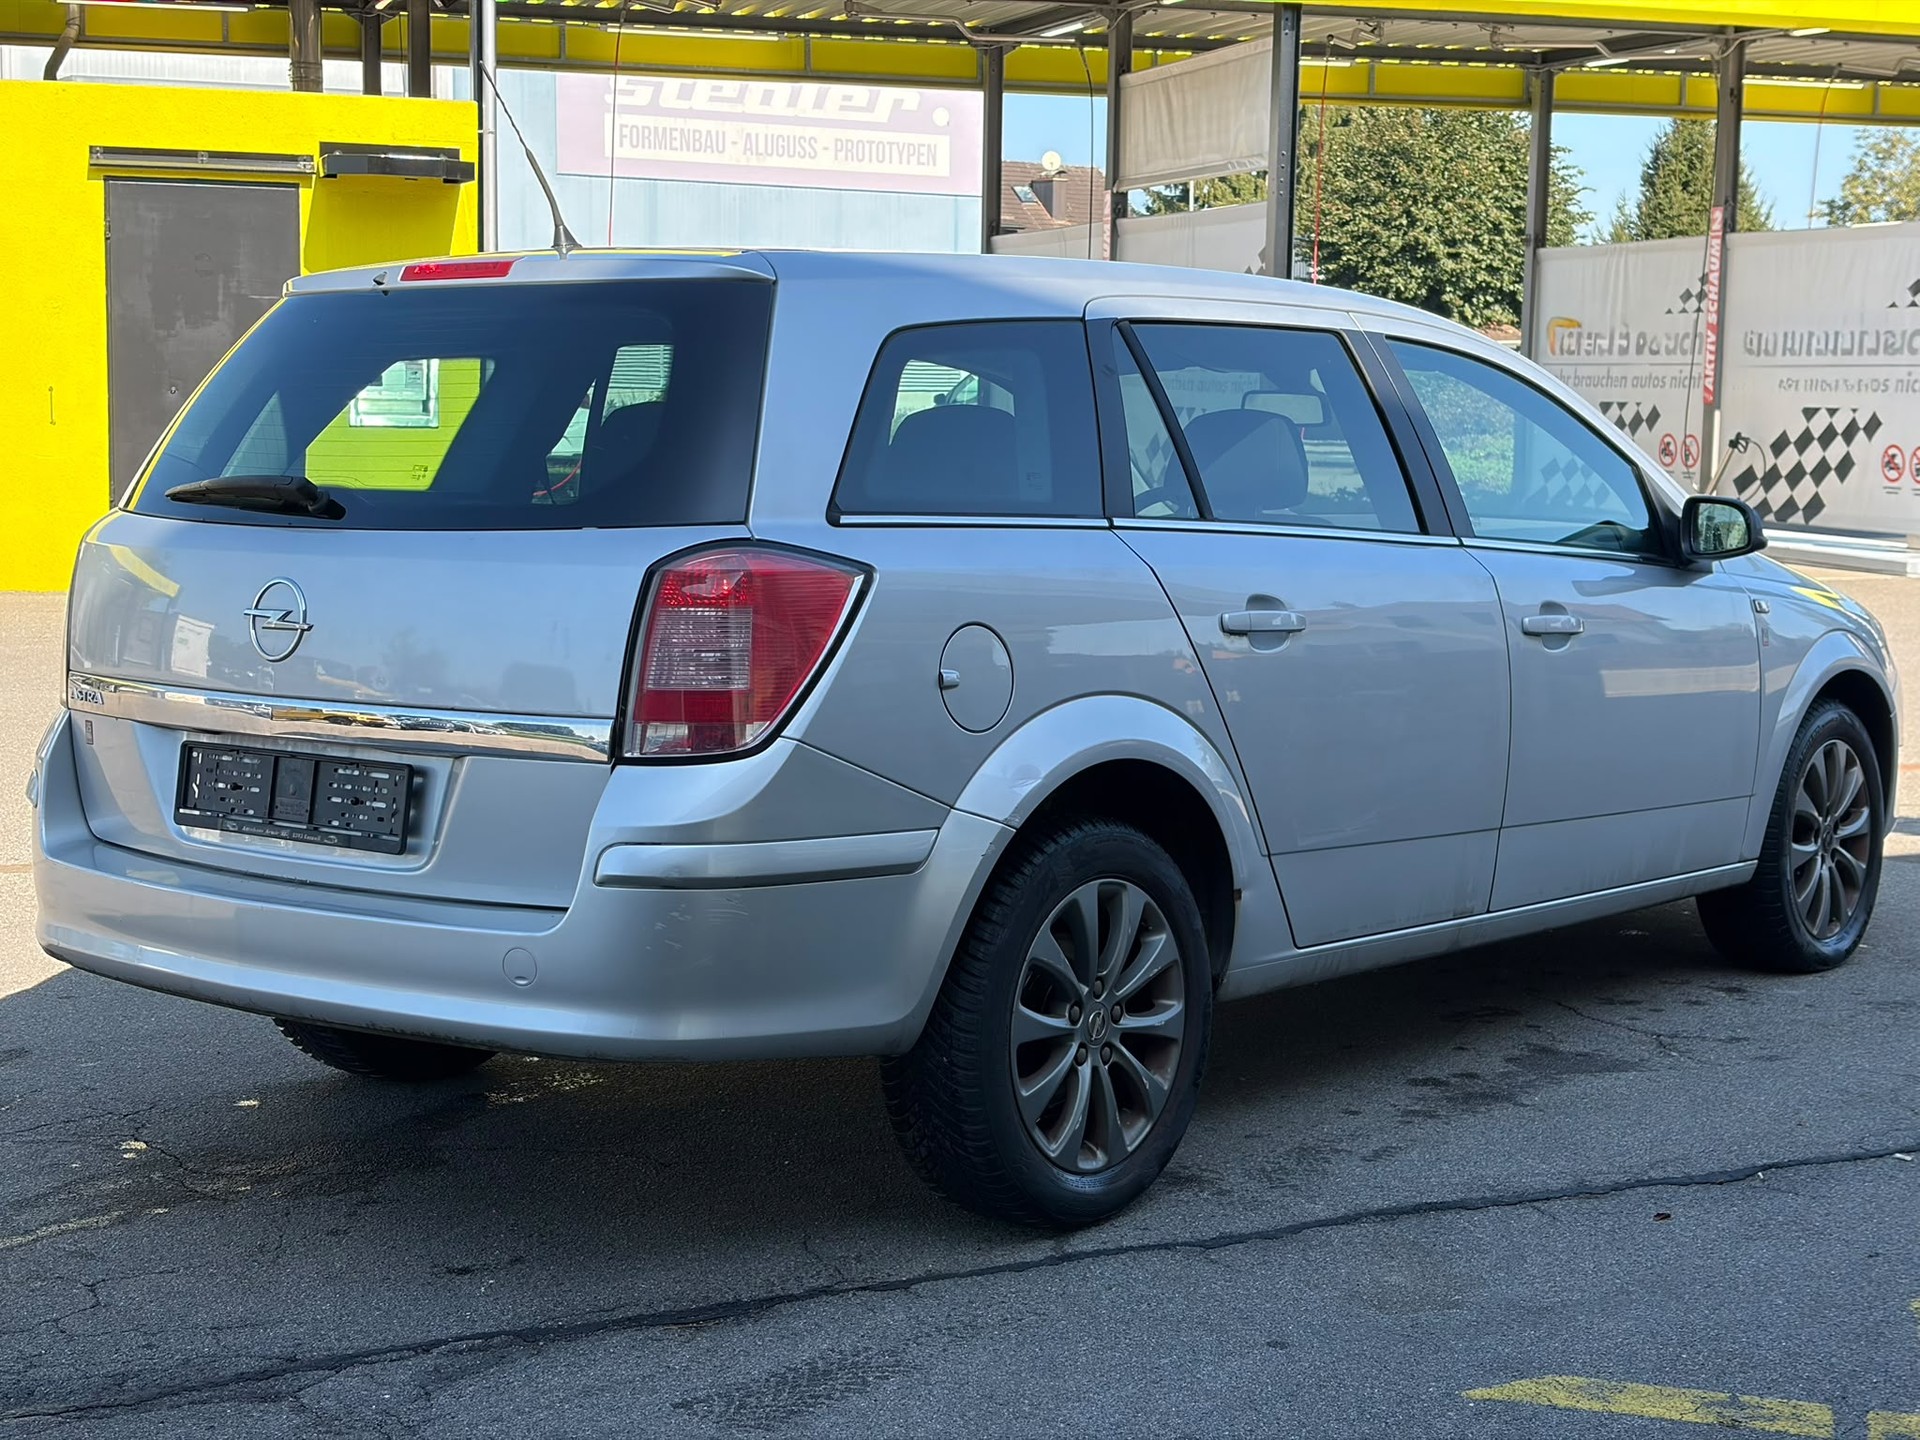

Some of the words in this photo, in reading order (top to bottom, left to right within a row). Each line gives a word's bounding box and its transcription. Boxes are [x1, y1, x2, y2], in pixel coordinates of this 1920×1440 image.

[618, 123, 727, 155] FORMENBAU
[742, 134, 818, 161] ALUGUSS
[834, 138, 938, 168] PROTOTYPEN
[1707, 238, 1723, 326] SCHAUM
[1573, 367, 1628, 388] brauchen
[1631, 372, 1666, 389] autos
[1704, 329, 1718, 391] AKTIV
[70, 687, 104, 705] ASTRA
